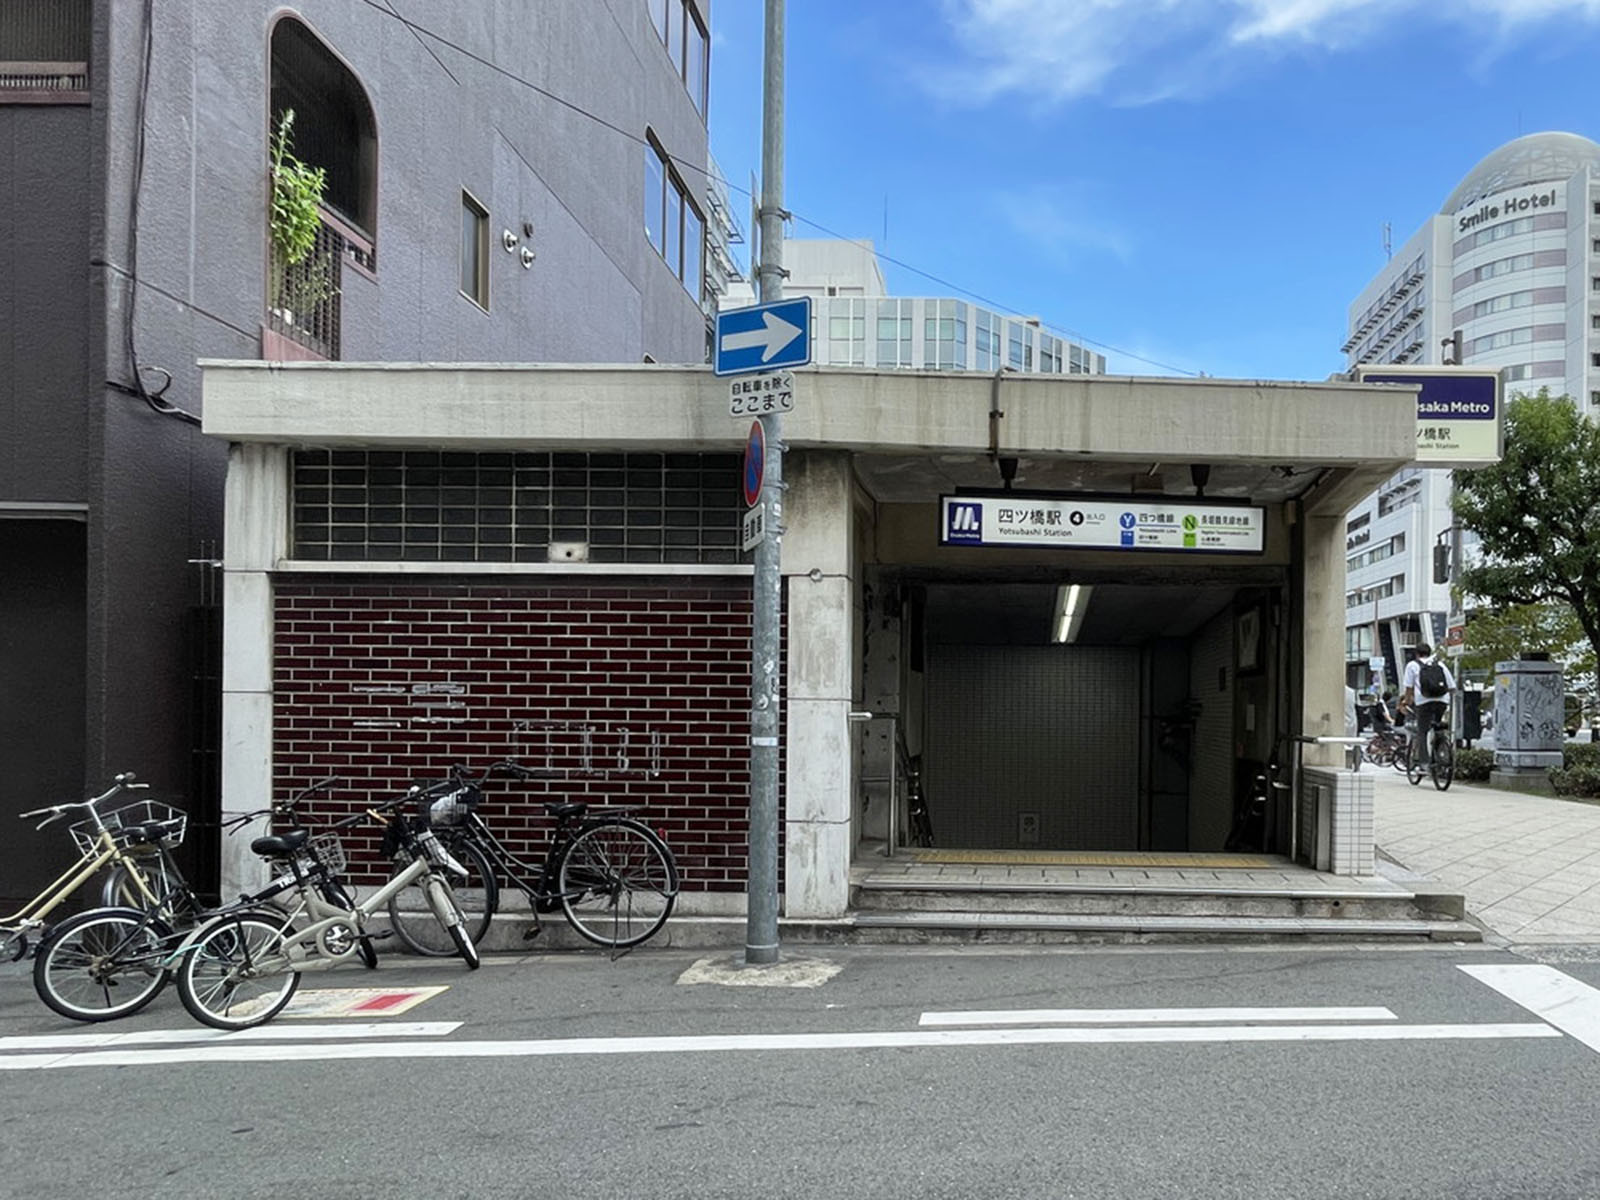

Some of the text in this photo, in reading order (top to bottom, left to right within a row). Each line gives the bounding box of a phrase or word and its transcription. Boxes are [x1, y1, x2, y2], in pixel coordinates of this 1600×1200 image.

[1459, 189, 1556, 232] Smile Hotel
[732, 377, 790, 396] 自転車を除く
[731, 392, 792, 414] ここまで
[1417, 401, 1490, 414] saka Metro
[998, 508, 1062, 526] 四ツ橋駅
[998, 527, 1073, 537] Yotsubashi Station
